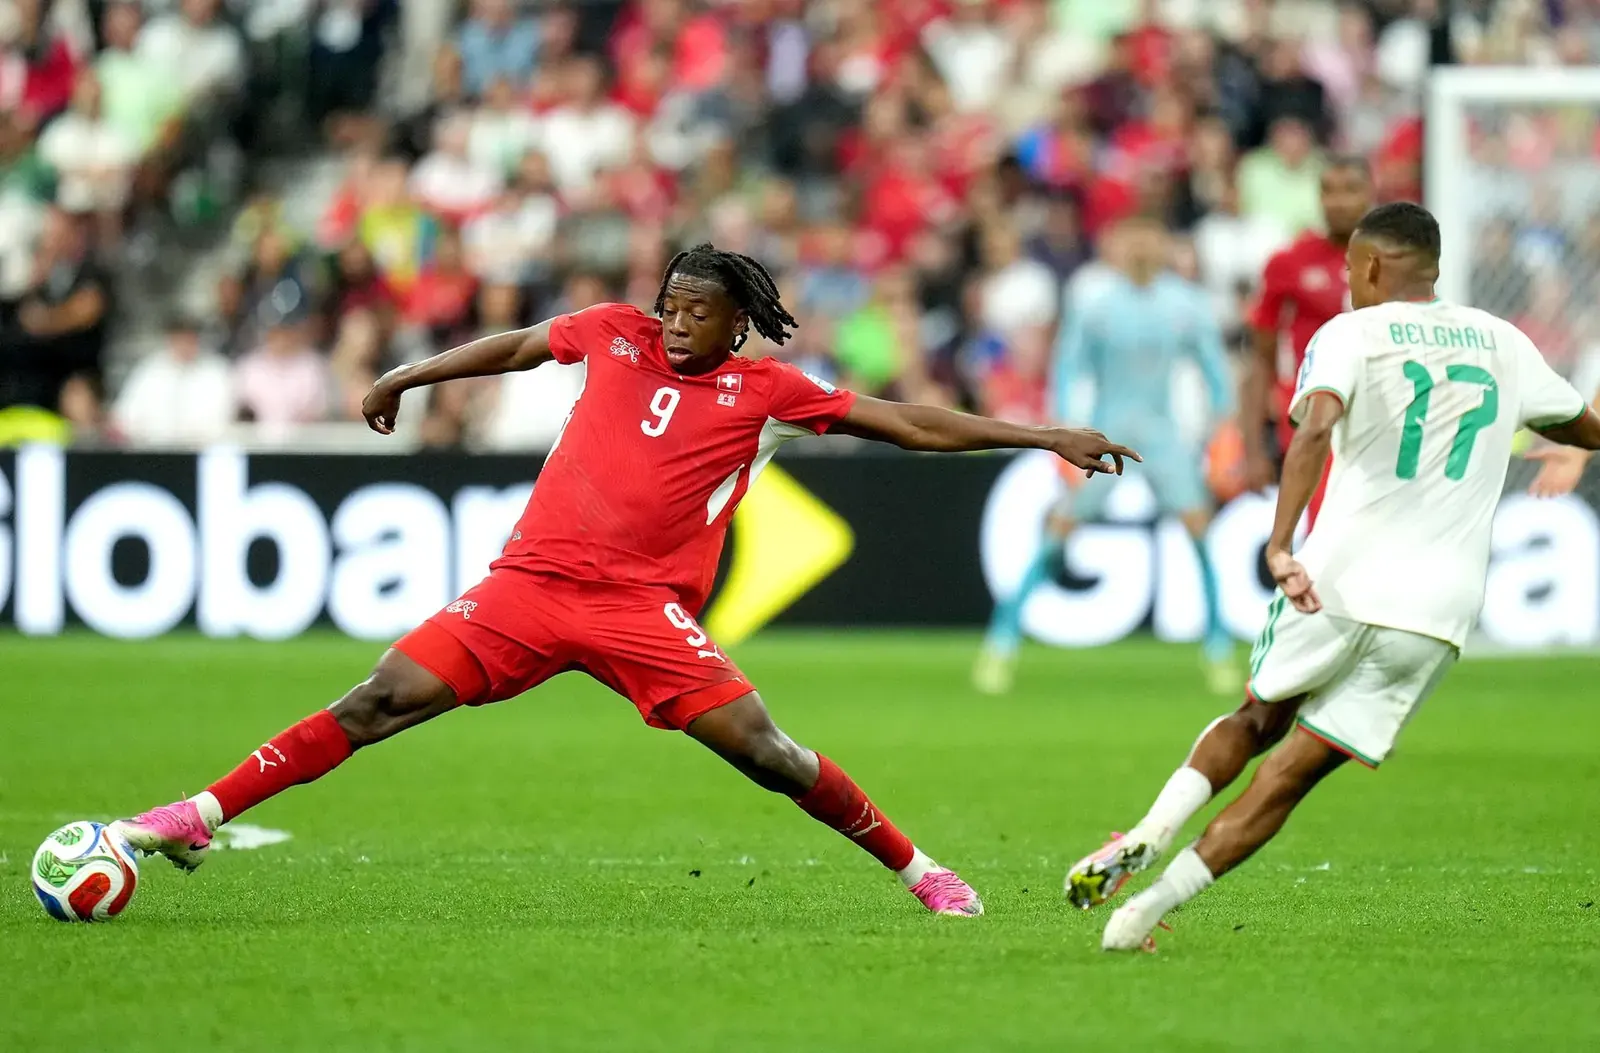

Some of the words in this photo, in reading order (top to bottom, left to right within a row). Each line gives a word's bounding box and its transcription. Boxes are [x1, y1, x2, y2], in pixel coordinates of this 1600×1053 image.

[641, 387, 680, 437] 9
[1396, 360, 1499, 480] 17
[0, 443, 540, 639] loba
[664, 603, 706, 647] 9
